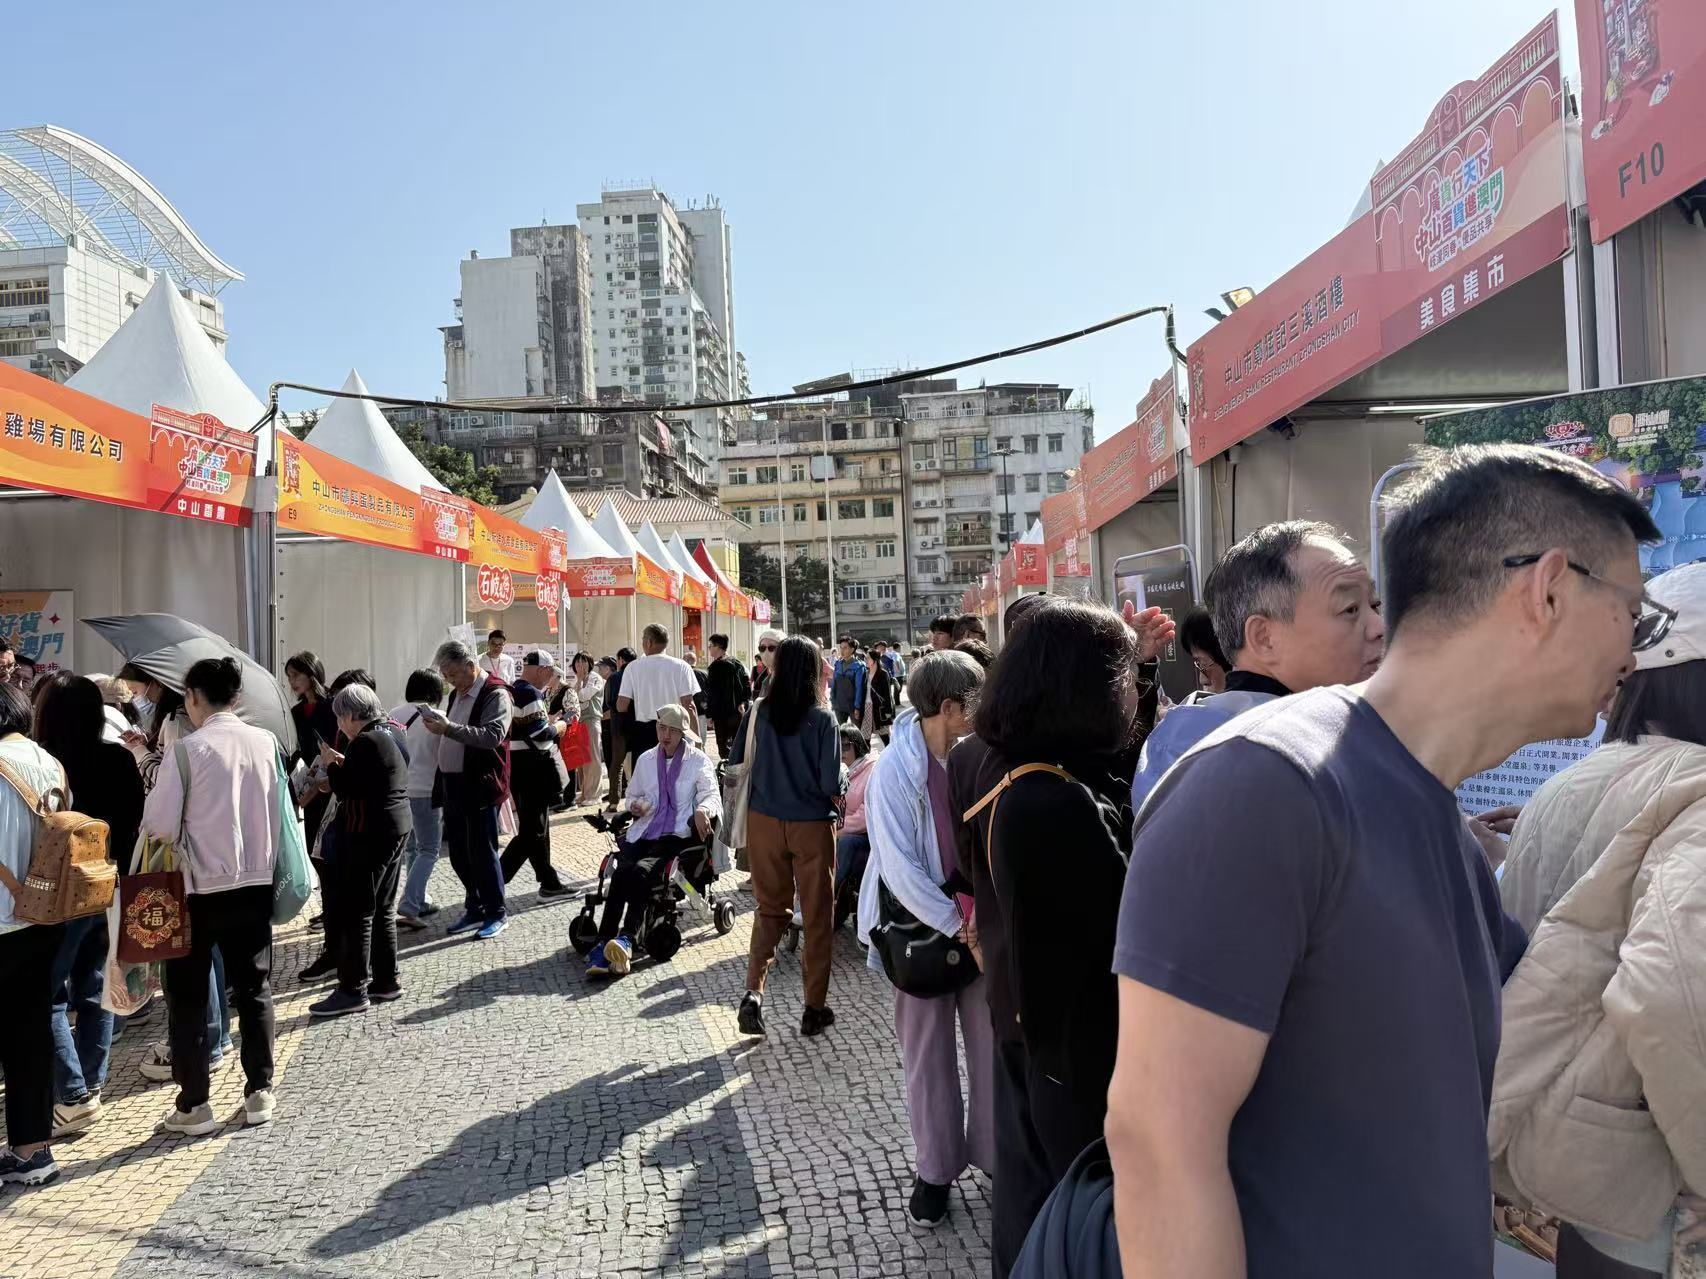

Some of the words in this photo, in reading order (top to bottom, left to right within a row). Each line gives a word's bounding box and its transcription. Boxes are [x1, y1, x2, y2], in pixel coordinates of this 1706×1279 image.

[1618, 142, 1664, 198] F10
[1416, 168, 1503, 262] 中山百貨進澳門
[1420, 254, 1504, 330] 美食集市
[1300, 324, 1341, 362] ZHONGSHAN
[1343, 309, 1360, 333] CITY
[4, 412, 124, 463] 雞場有限公司
[288, 508, 297, 520] E9
[142, 907, 164, 926] 福
